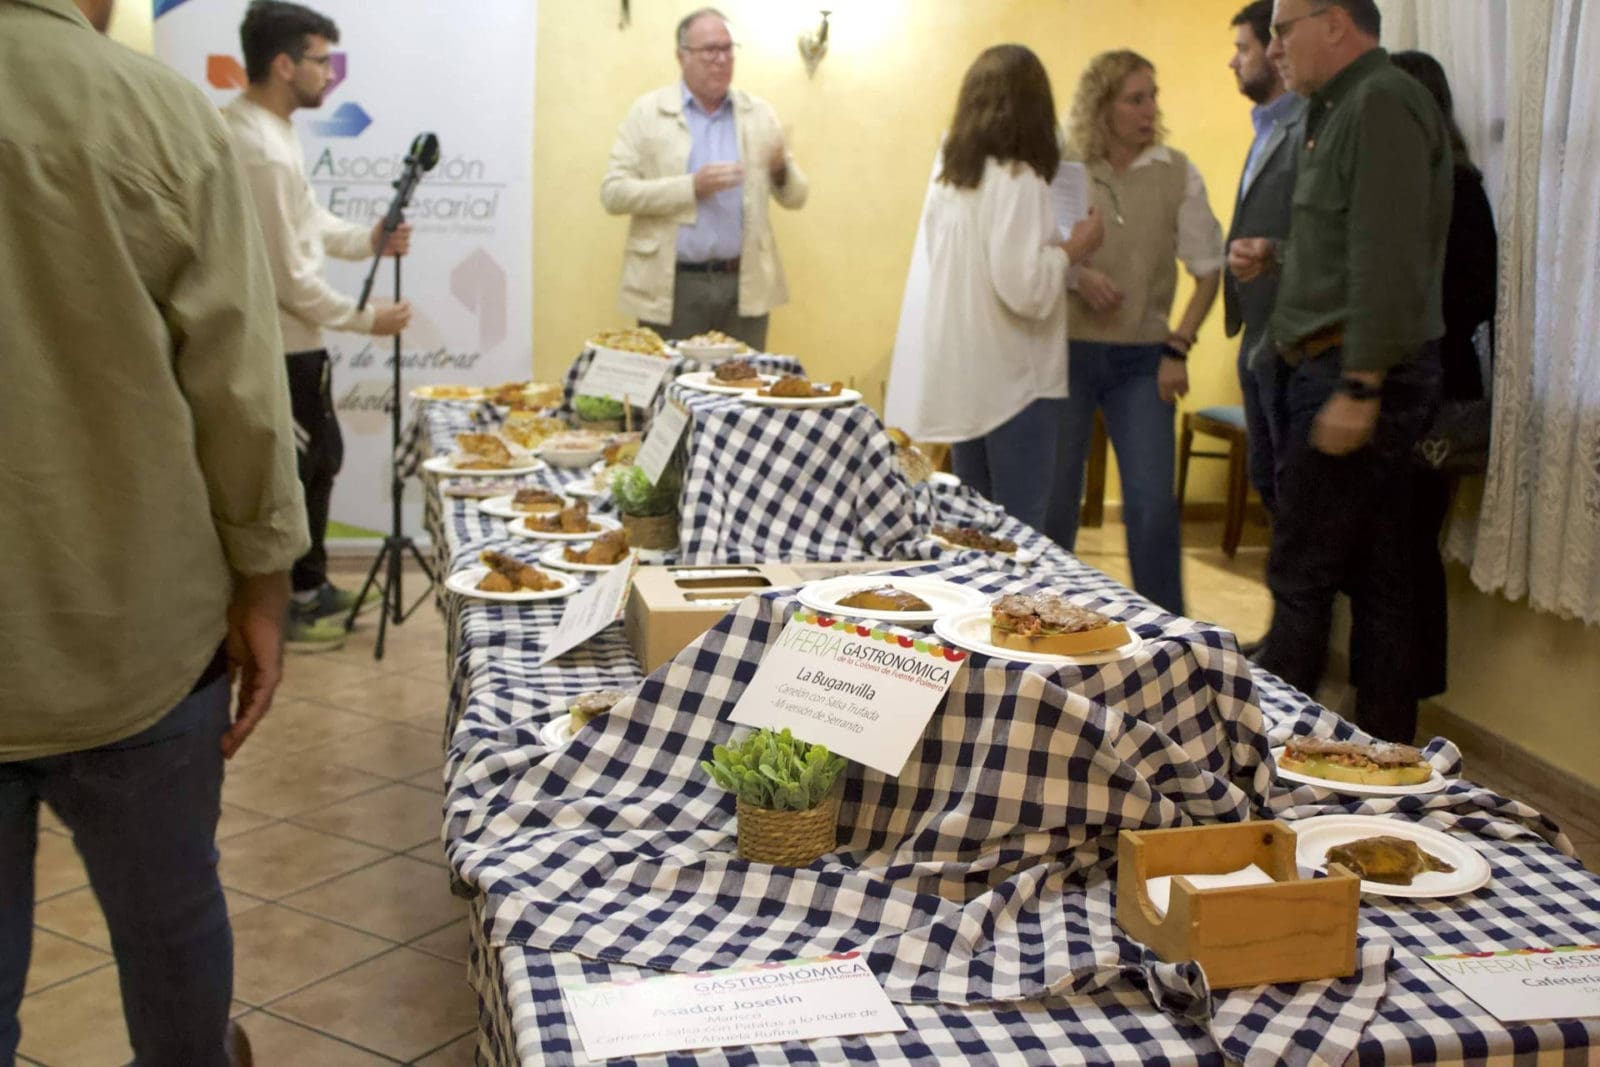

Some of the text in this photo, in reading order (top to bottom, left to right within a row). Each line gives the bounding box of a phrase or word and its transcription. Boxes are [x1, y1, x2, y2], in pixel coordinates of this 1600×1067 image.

[312, 147, 484, 179] Asociión
[328, 186, 499, 219] Empesarial
[842, 642, 951, 685] GASTRONÓMICA
[796, 666, 877, 701] La Buganvilla
[694, 963, 868, 993] GASTRONÓMICA
[652, 994, 803, 1017] Asador Joselín
